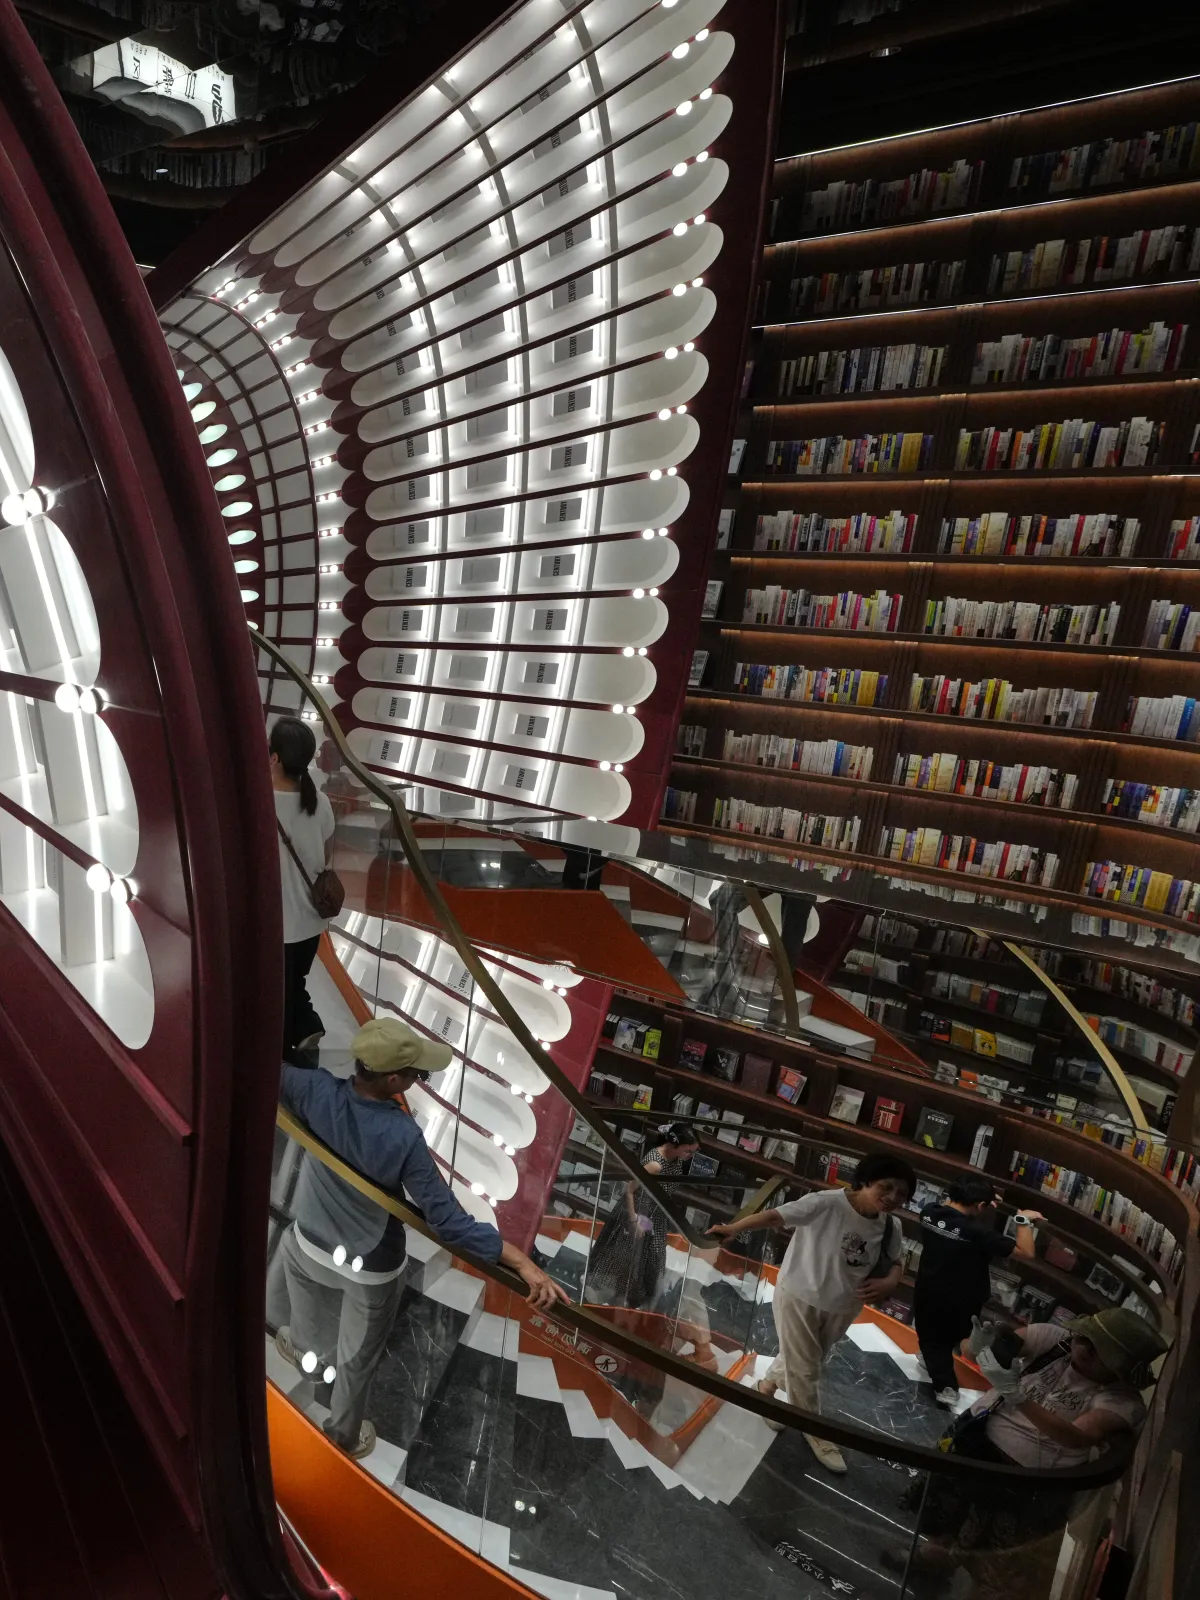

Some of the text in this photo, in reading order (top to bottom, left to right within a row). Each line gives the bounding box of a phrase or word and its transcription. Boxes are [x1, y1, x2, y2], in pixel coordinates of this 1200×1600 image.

[568, 336, 576, 358] CENTURY
[568, 393, 576, 414] CENTURY
[564, 447, 572, 468] CENTURY
[559, 502, 567, 523] CENTURY
[553, 557, 561, 578] CENTURY
[402, 611, 410, 632] CENTURY
[545, 610, 554, 631] CENTURY
[396, 654, 404, 675] CENTURY
[537, 663, 546, 684] CENTURY
[389, 697, 398, 718] CENTURY
[527, 716, 536, 737] CENTURY
[381, 740, 390, 761] CENTURY
[516, 768, 526, 788] CENTURY
